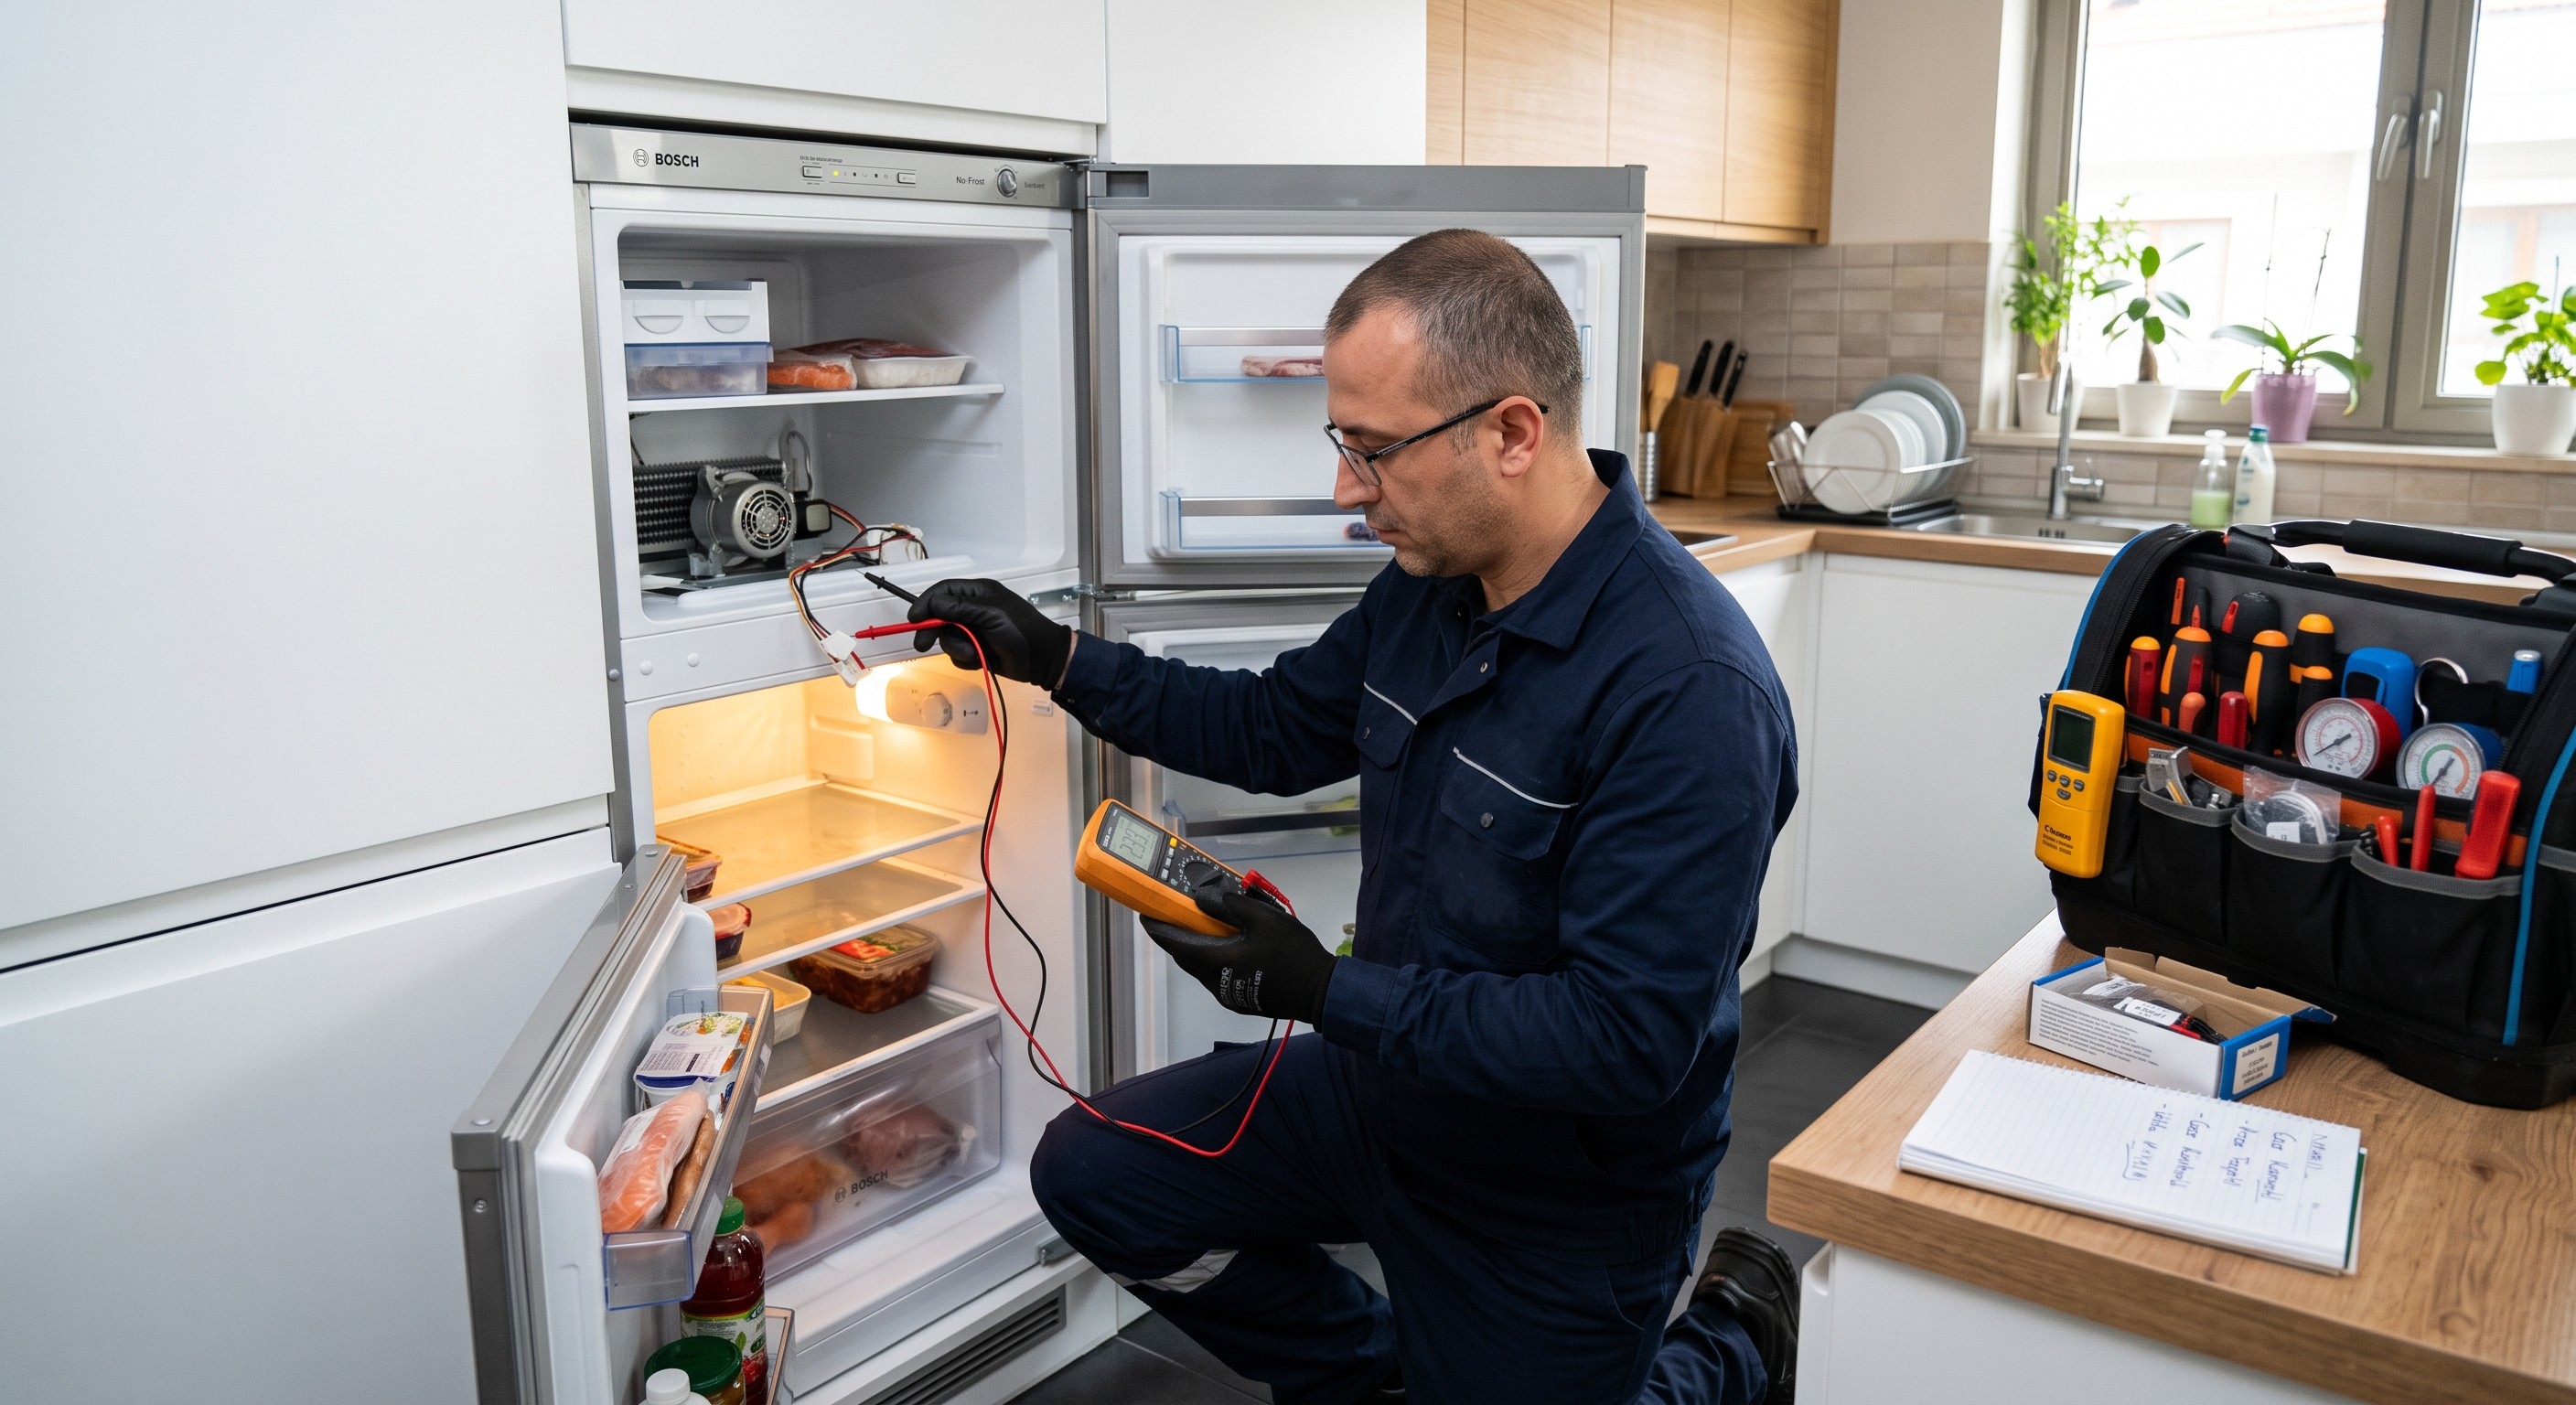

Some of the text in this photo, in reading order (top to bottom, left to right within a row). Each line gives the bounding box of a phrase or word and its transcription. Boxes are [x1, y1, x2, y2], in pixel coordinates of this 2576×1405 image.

[655, 153, 699, 167] BOSCH
[968, 177, 985, 186] Frost
[851, 1169, 888, 1196] BOSCH
